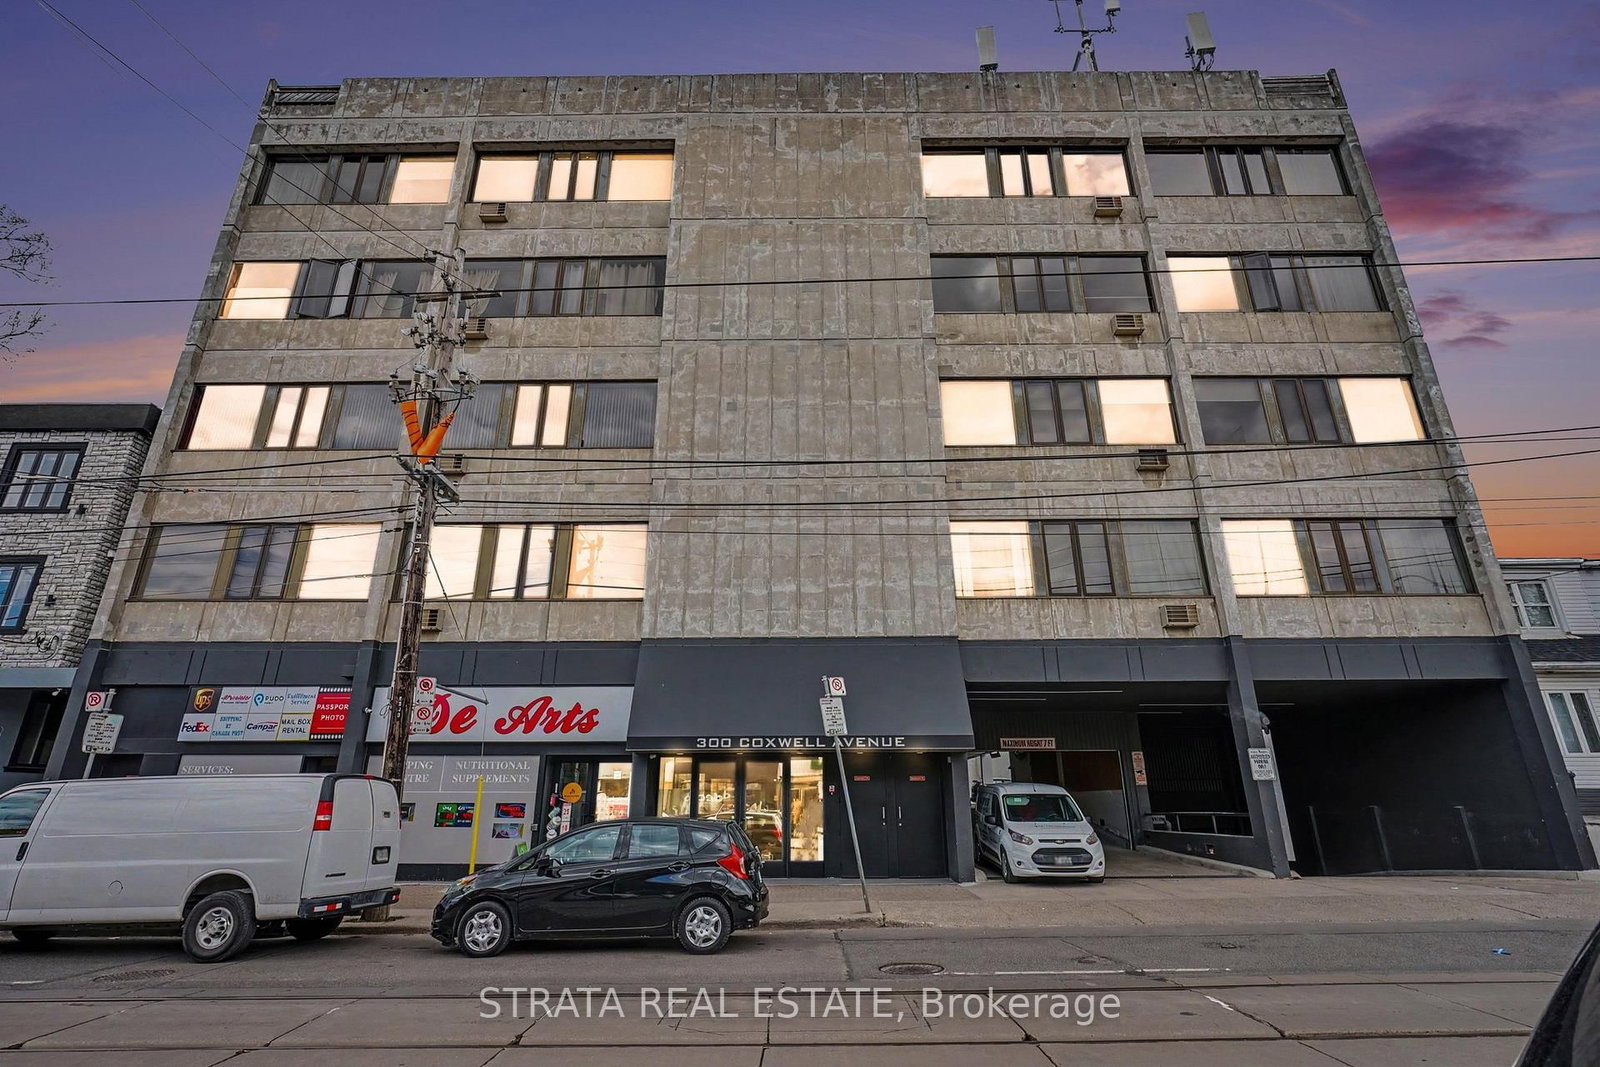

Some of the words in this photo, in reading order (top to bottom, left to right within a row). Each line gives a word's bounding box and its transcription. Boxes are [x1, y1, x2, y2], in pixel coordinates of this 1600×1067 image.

[495, 696, 600, 735] Arts
[181, 721, 210, 733] FedEx
[246, 722, 278, 733] Canpar
[696, 737, 731, 748] 300
[739, 737, 826, 748] COXWELL
[832, 736, 905, 748] AVENUE
[181, 765, 234, 775] SERVICES:
[405, 760, 433, 770] PING
[455, 760, 531, 770] NUTRITIONAL
